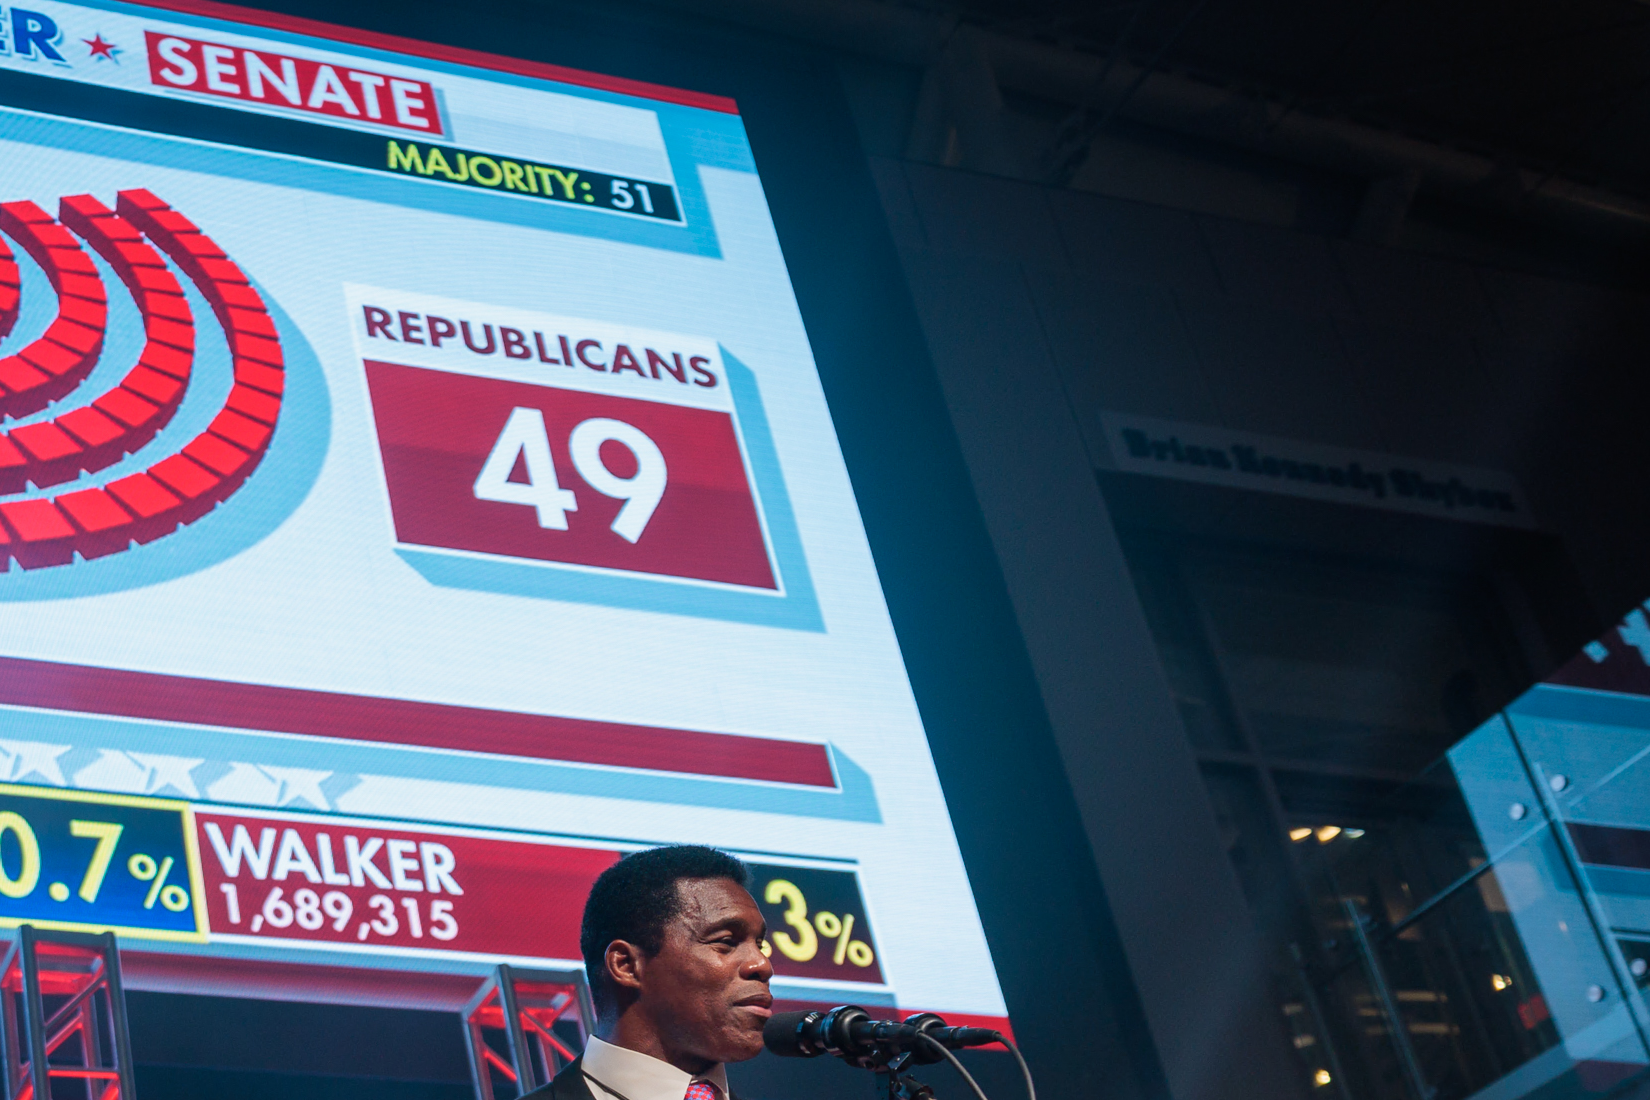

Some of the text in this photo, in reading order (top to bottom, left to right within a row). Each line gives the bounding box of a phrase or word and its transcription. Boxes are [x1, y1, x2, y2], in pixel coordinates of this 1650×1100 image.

[157, 39, 433, 132] SENATE
[386, 141, 657, 215] MAJORITY: 51
[362, 305, 718, 389] REPUBLICANS
[473, 406, 668, 546] 49
[204, 822, 464, 895] WALKER
[219, 883, 459, 942] 1,689,315
